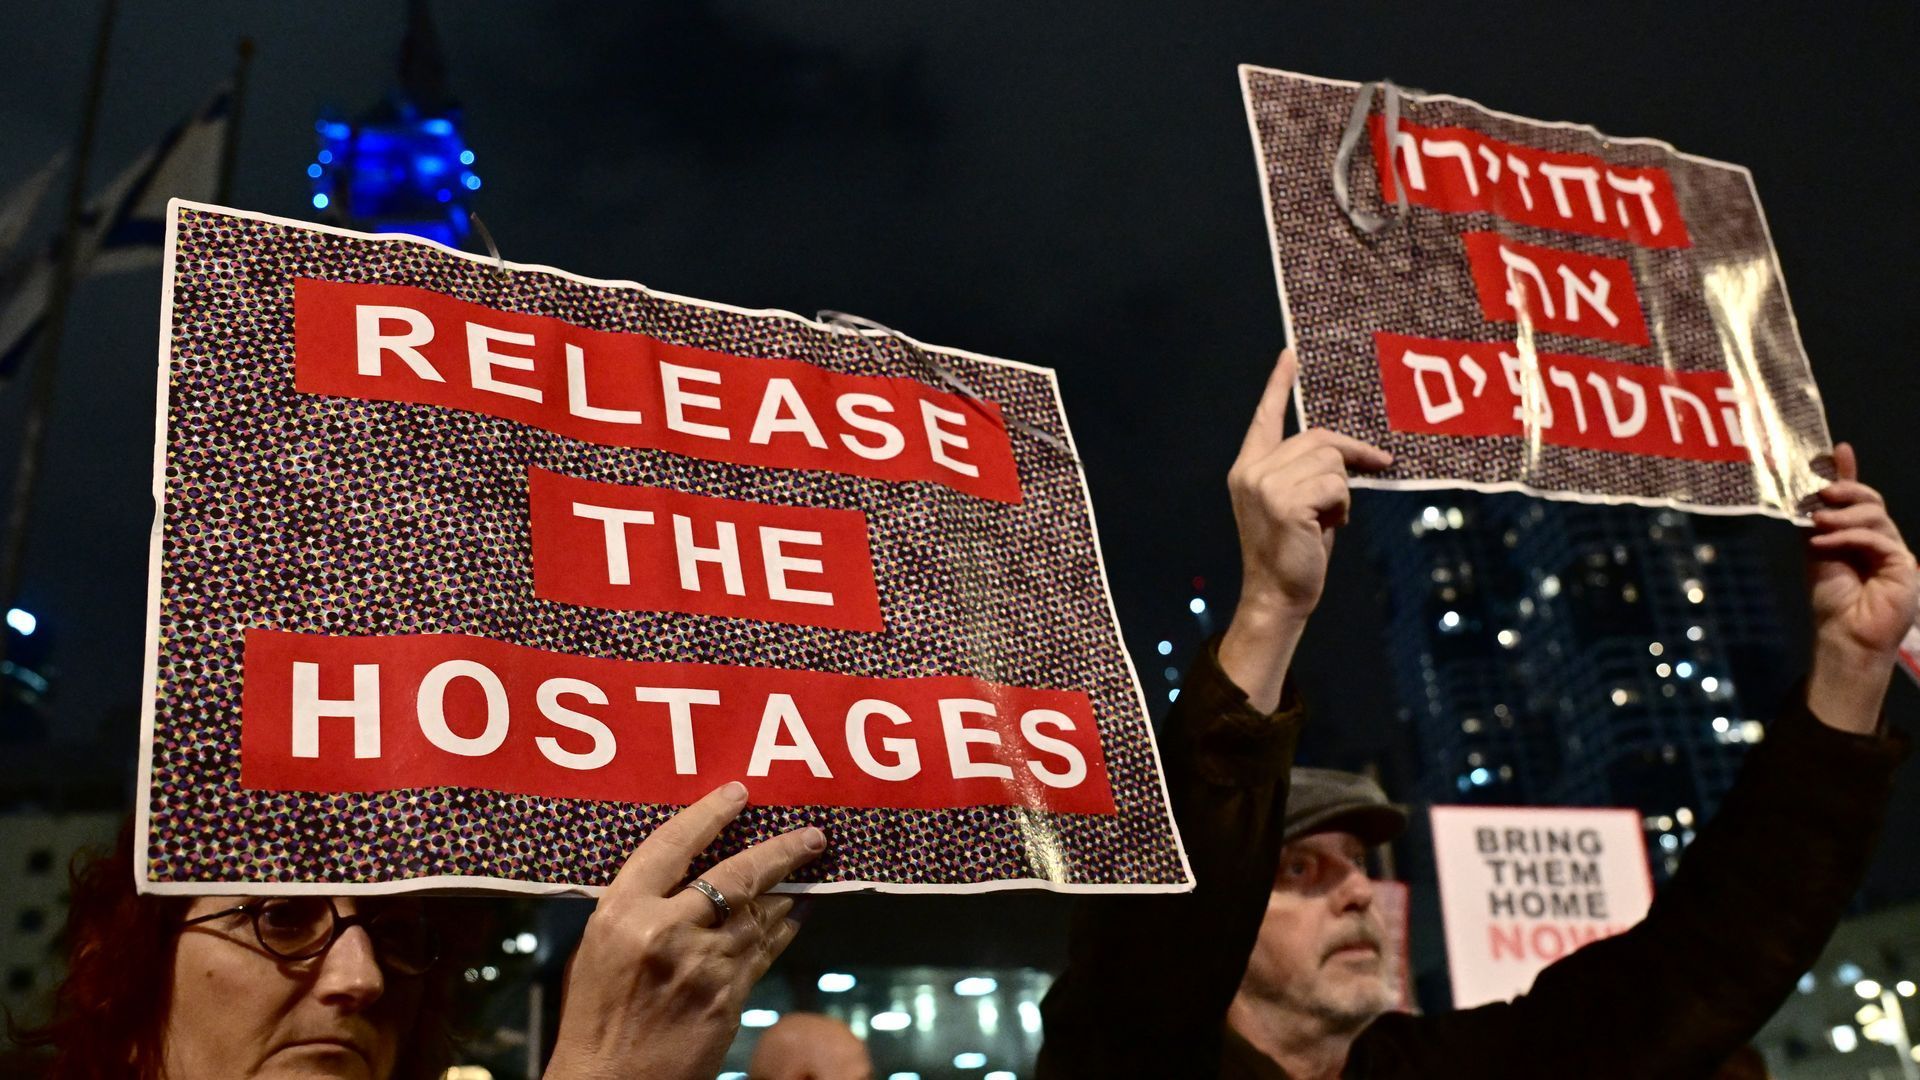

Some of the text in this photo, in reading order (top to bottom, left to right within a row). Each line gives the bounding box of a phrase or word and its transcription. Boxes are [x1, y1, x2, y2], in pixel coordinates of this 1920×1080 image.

[1393, 131, 1663, 235] החזירו
[1499, 245, 1620, 328] את
[354, 304, 980, 478] RELEASE
[571, 502, 835, 607] THE
[290, 660, 1089, 790] HOSTAGES
[1475, 827, 1602, 855] BRING
[1485, 859, 1602, 887] THEM
[1488, 892, 1607, 918] HOME
